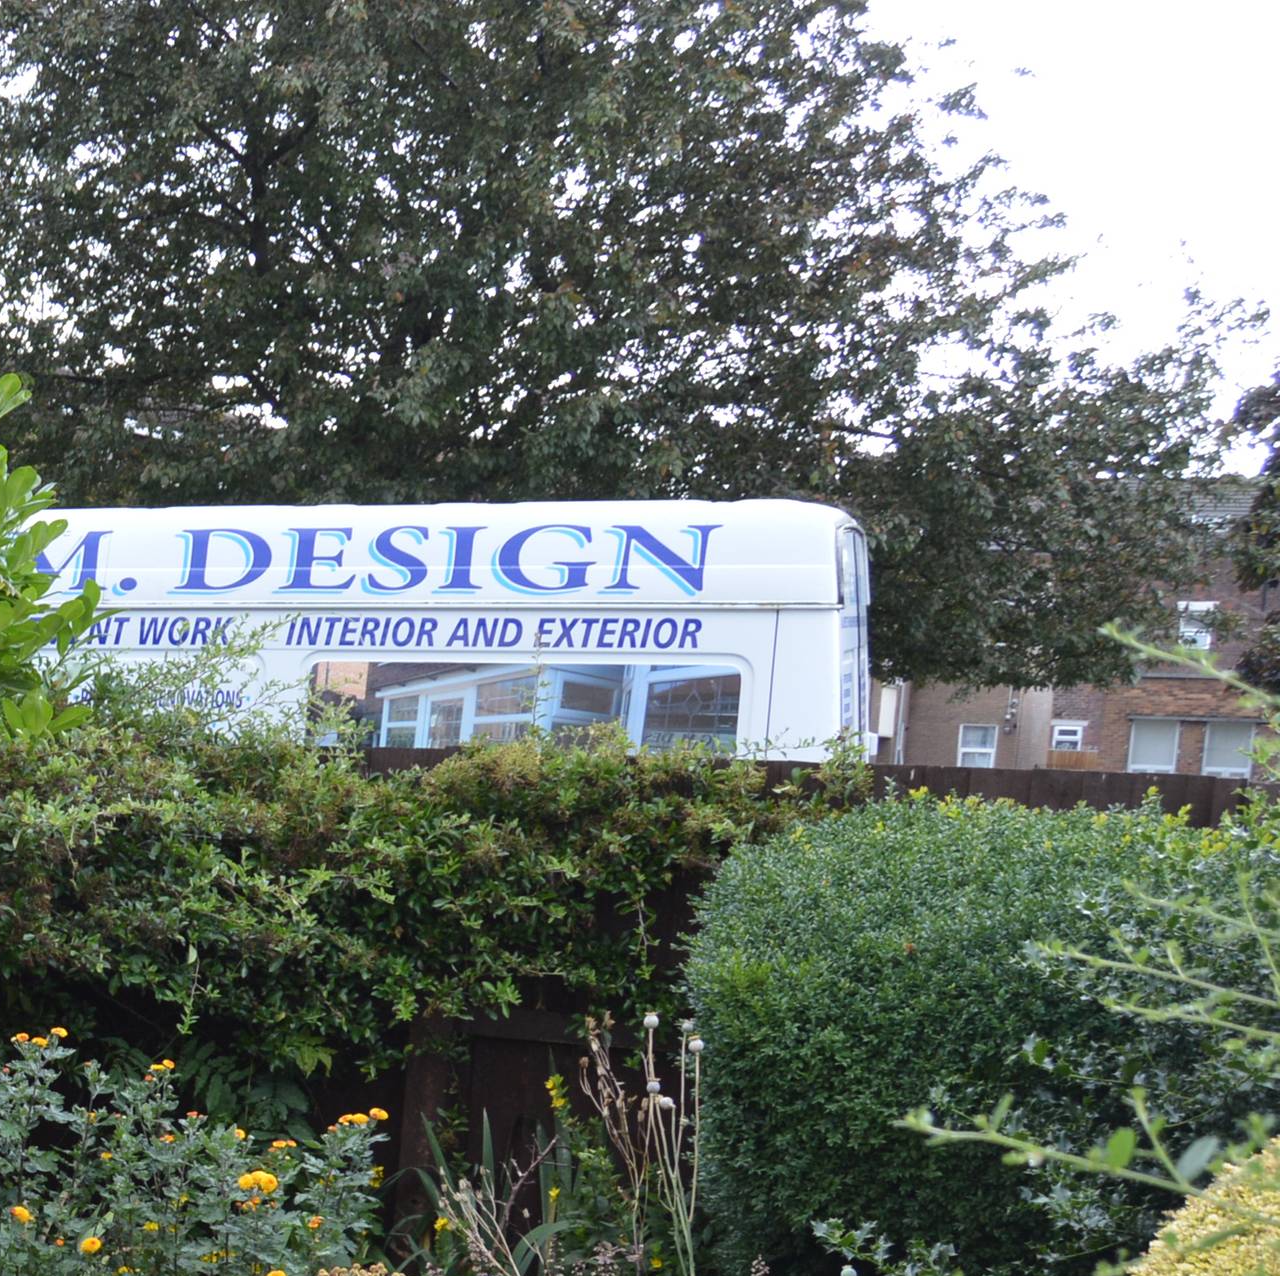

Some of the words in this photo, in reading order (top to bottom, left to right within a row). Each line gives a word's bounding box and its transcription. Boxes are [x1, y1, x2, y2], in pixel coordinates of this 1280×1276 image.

[166, 525, 723, 597] DESIGN
[137, 616, 235, 646] WORK
[284, 616, 439, 648] INTERIOR
[446, 617, 524, 648] AND
[535, 617, 703, 650] EXTERIOR
